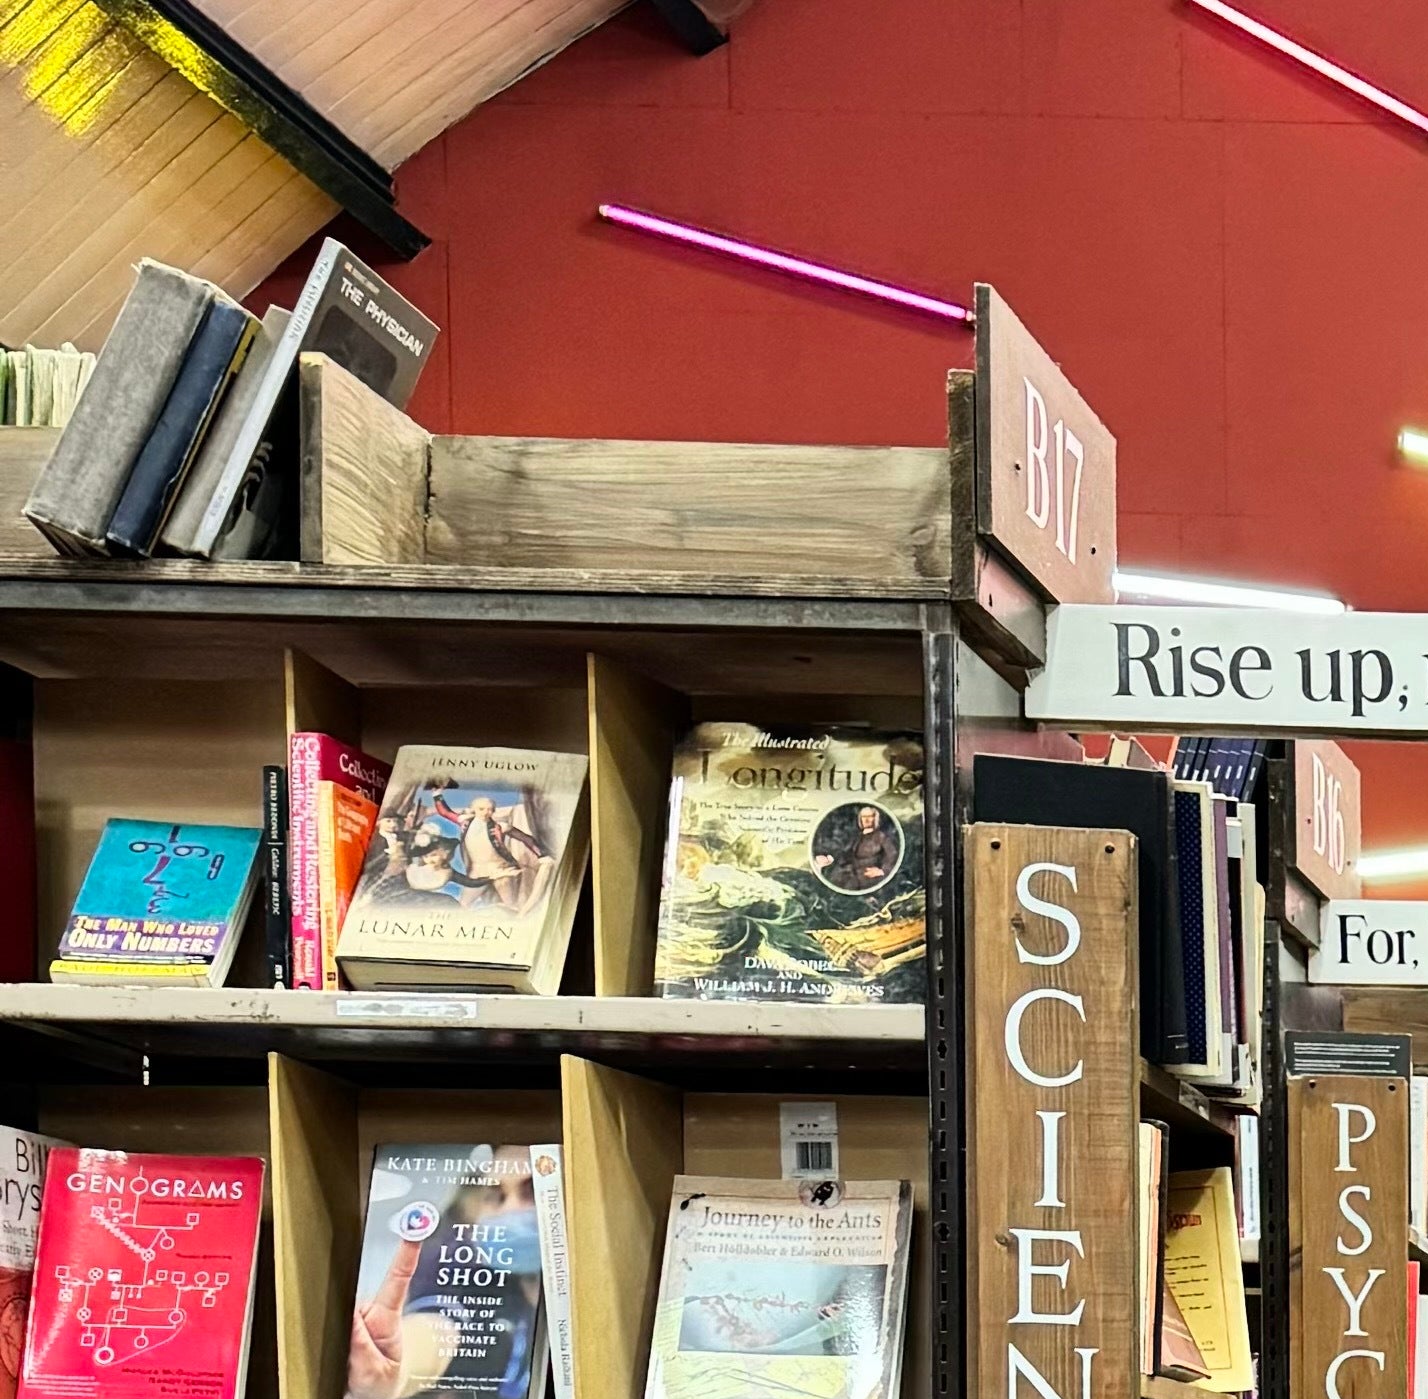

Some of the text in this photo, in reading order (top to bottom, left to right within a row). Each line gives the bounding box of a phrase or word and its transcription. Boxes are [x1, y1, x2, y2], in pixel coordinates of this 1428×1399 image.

[339, 275, 425, 359] THE PHYSICIAN
[1021, 376, 1084, 566] B17
[1112, 621, 1273, 701] Rise
[432, 757, 540, 772] JENNY UGLOW
[1311, 752, 1347, 877] B16
[360, 920, 513, 939] LUNAR MEN
[69, 931, 214, 953] ONLY NUMBERS
[1336, 915, 1419, 969] For,
[387, 1157, 532, 1175] KATE BINGHAM
[67, 1173, 243, 1200] GENOGRAMS
[701, 1207, 881, 1233] Journey to the Ants
[453, 1224, 506, 1242] THE
[439, 1246, 513, 1265] LONG
[437, 1268, 512, 1287] SHOT
[435, 1295, 503, 1305] THE INSIDE
[440, 1309, 475, 1317] STORY
